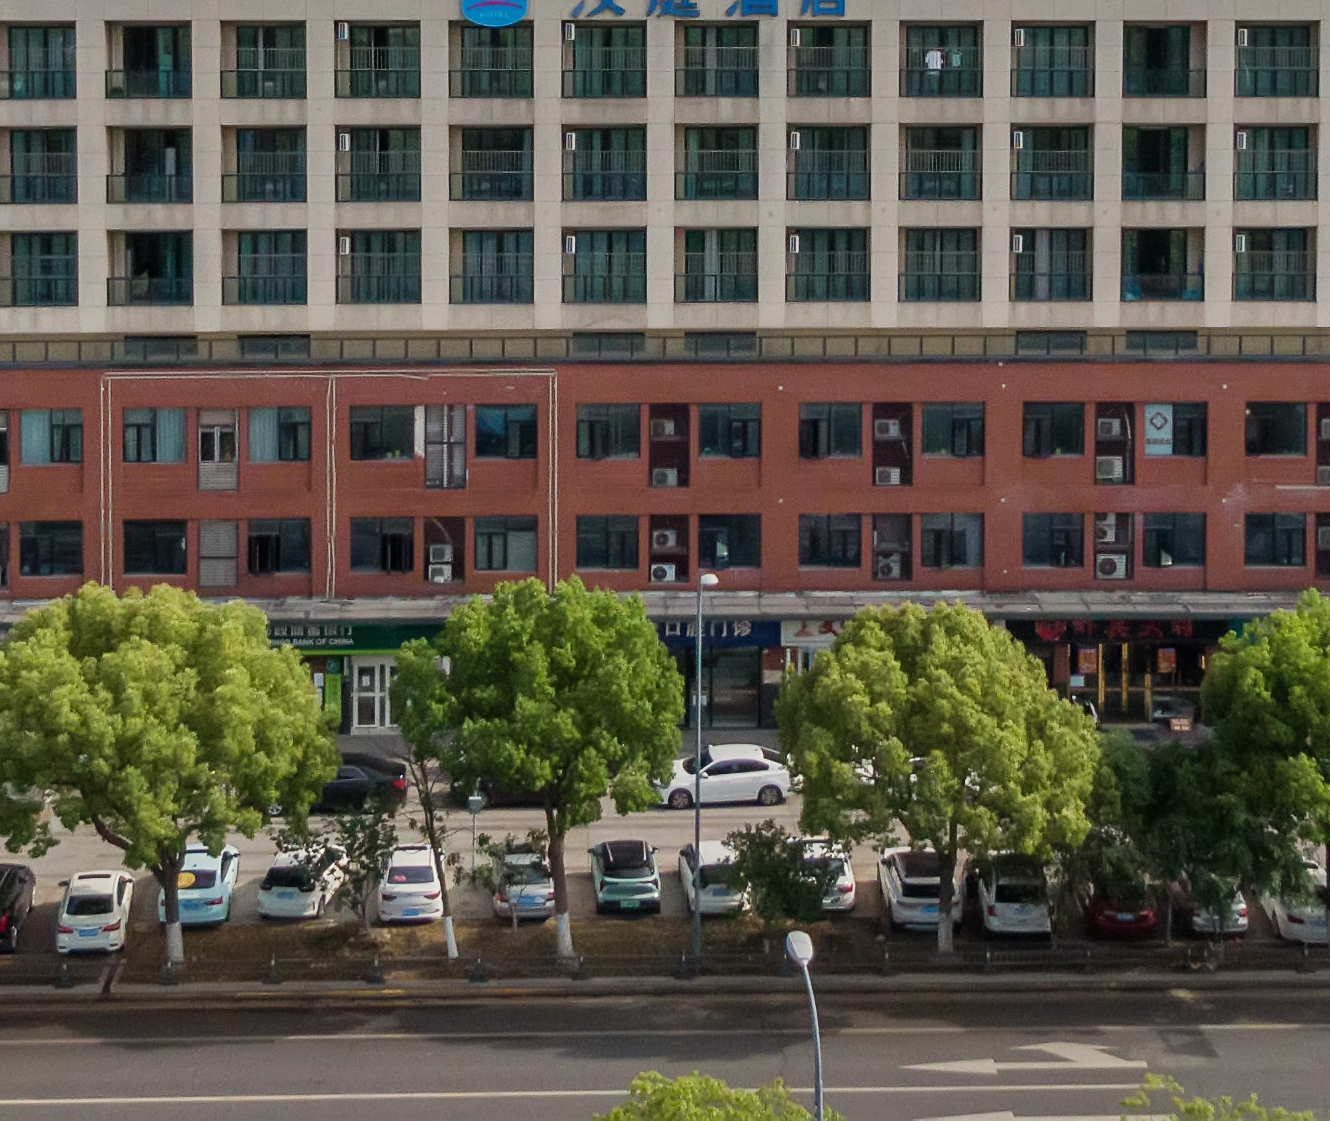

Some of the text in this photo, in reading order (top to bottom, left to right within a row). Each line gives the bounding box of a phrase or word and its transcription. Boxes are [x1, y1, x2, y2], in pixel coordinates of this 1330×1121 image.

[293, 638, 314, 646] BANK
[316, 638, 327, 646] OF
[329, 638, 354, 646] CHINA
